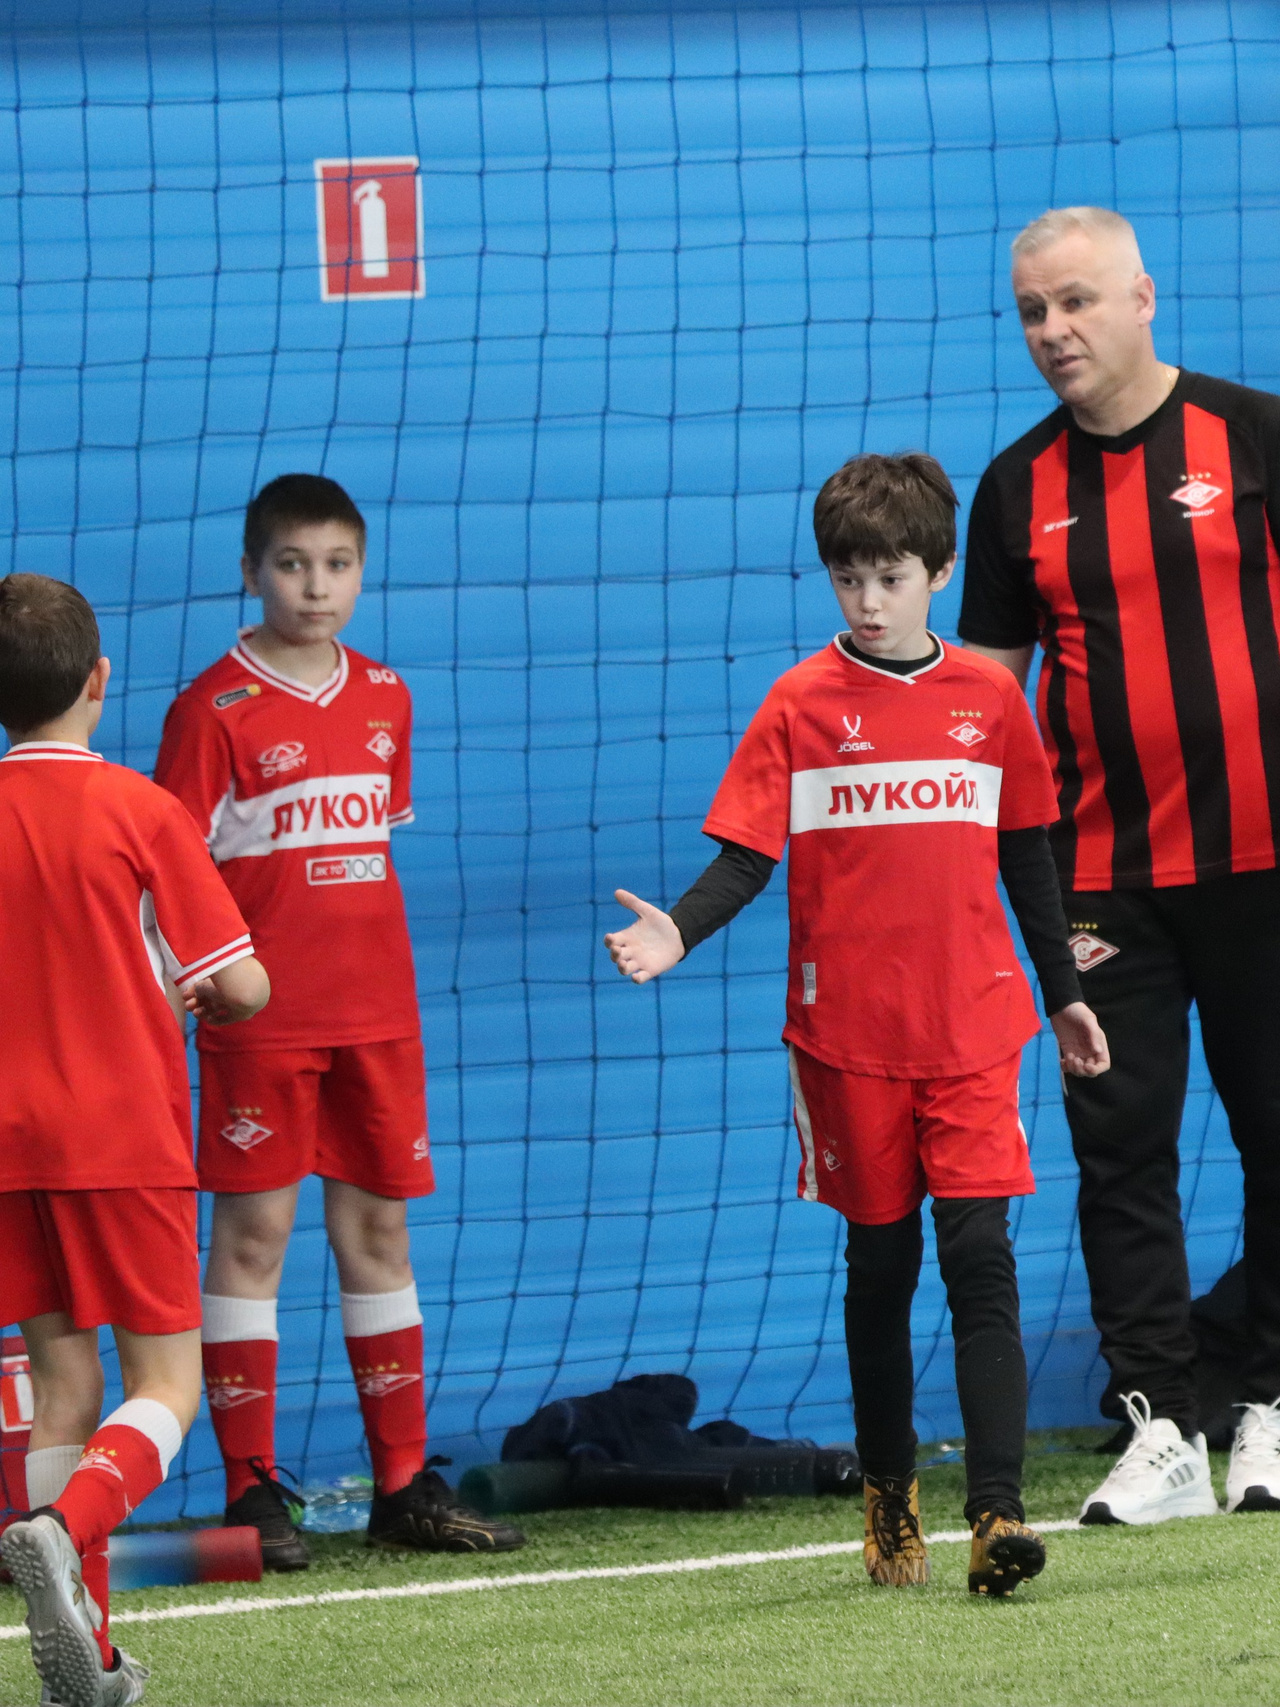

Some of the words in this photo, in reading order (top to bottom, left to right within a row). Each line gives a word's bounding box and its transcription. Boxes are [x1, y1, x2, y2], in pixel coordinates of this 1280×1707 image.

[366, 668, 398, 684] BQ
[837, 741, 876, 753] JÖGEL
[828, 771, 979, 816] ЛУКОЙЛ
